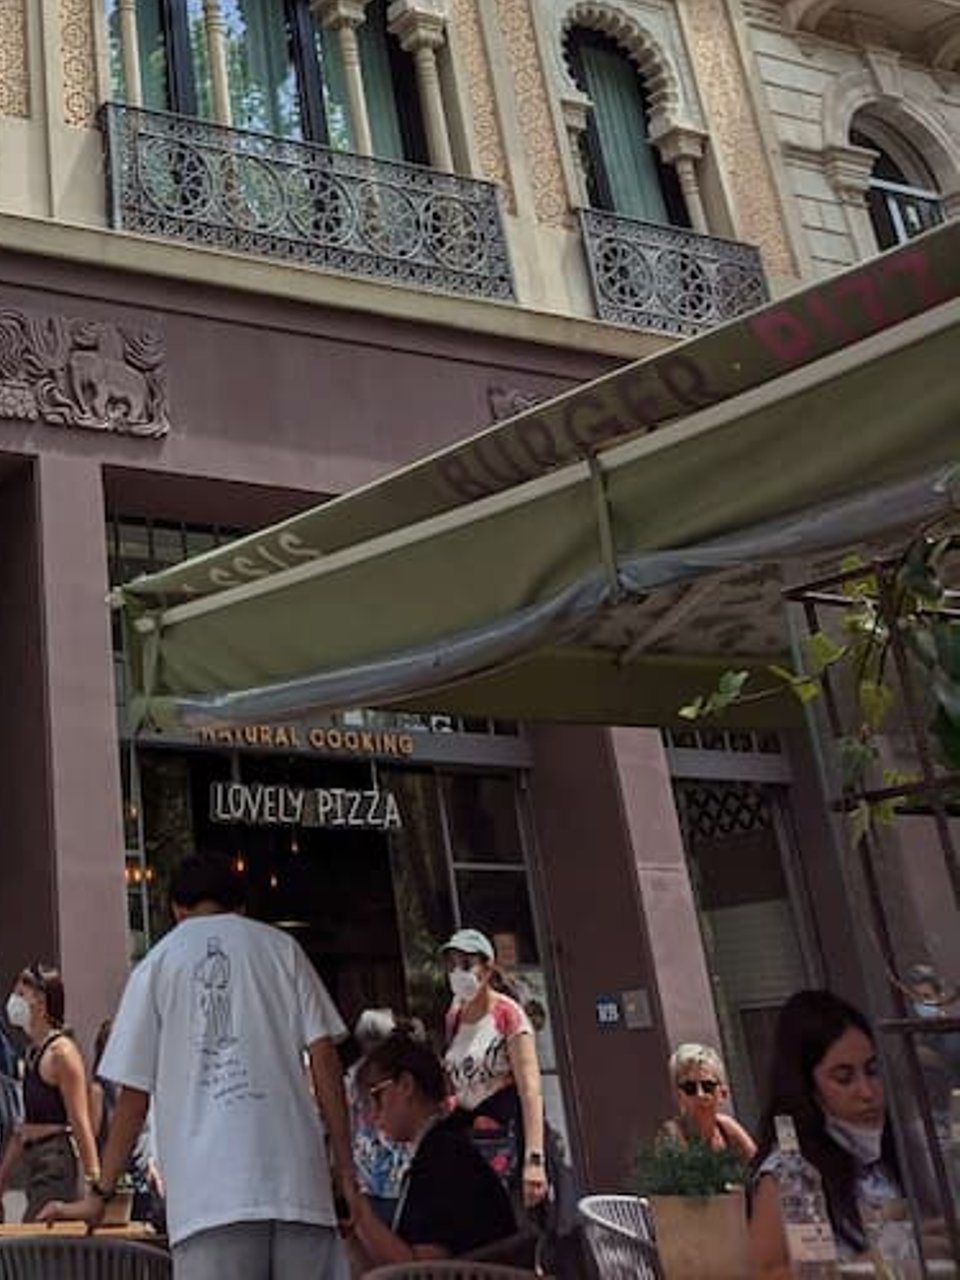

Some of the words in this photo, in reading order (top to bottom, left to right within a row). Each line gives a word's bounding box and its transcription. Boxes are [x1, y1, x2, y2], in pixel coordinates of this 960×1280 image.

[309, 727, 415, 756] COOKING
[214, 783, 304, 824] LOVELY
[316, 786, 403, 829] PIZZA
